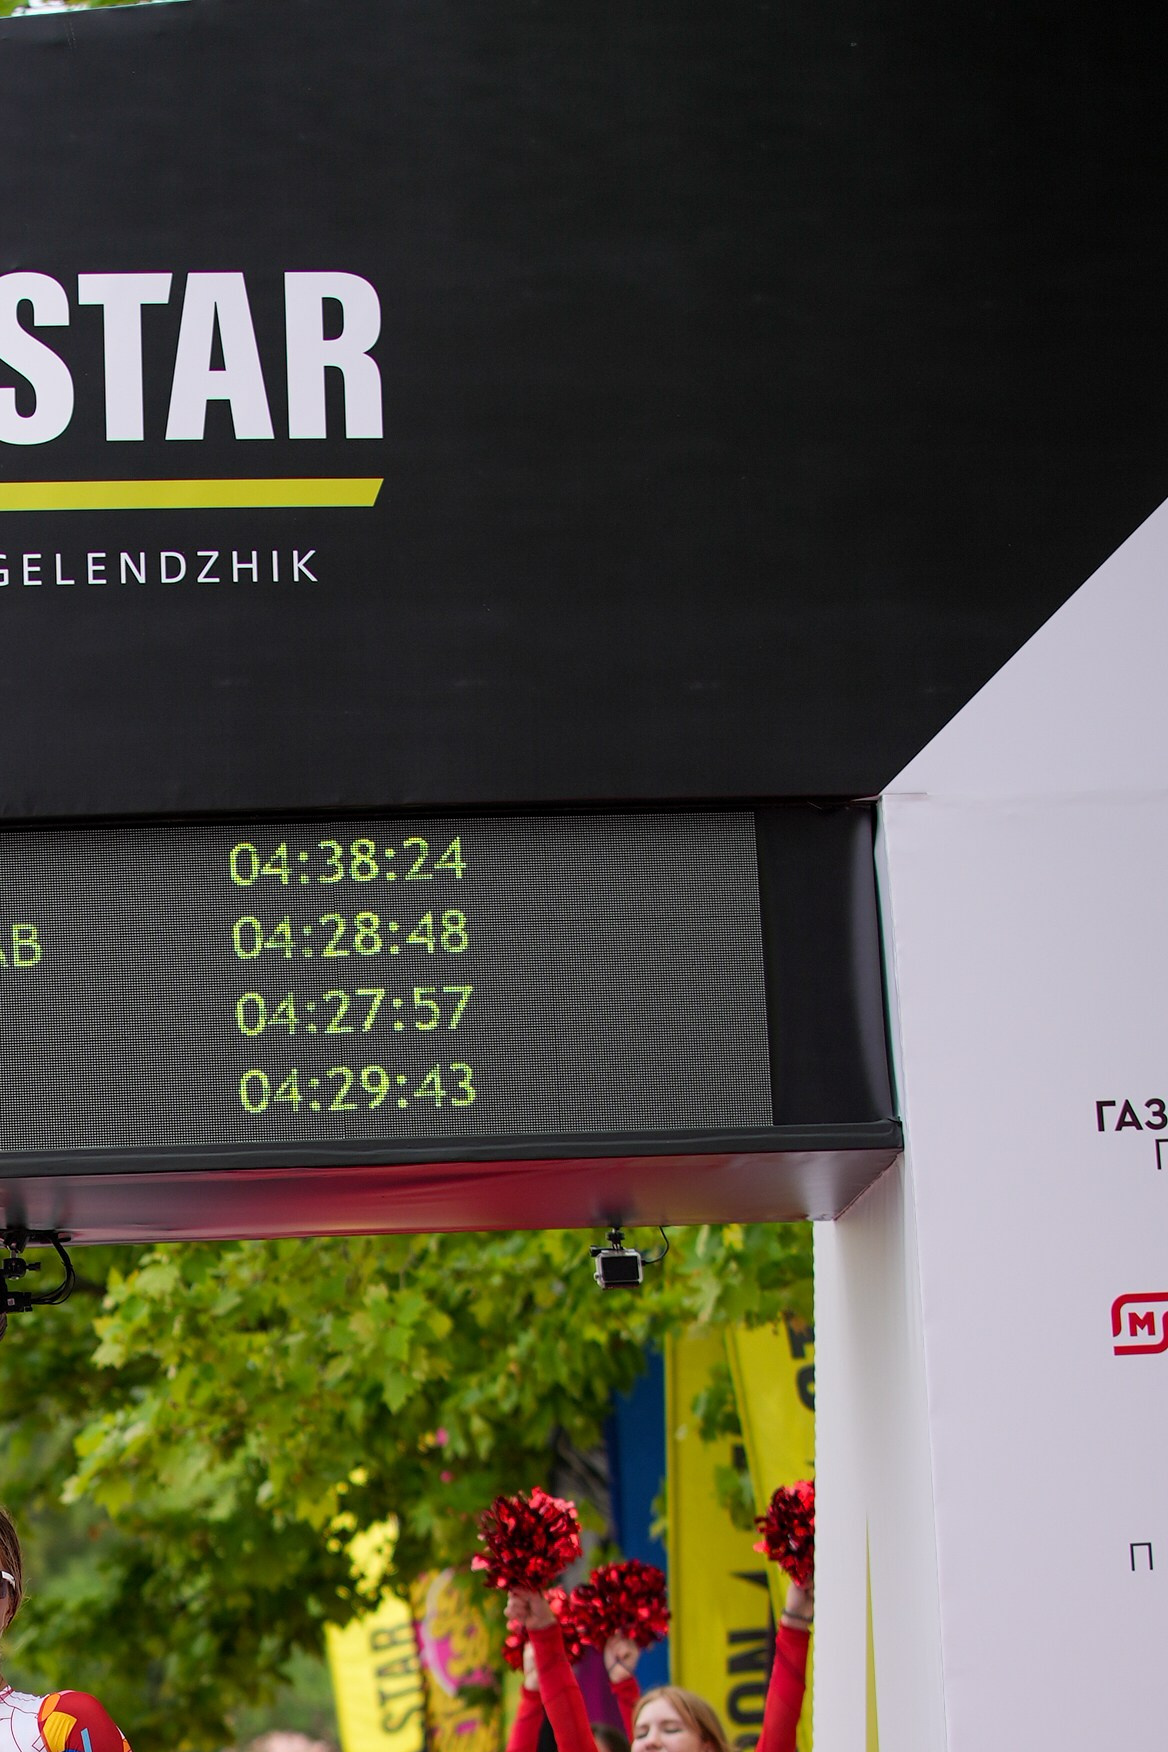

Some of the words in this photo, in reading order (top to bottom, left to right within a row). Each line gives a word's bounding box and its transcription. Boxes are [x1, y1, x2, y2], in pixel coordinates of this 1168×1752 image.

[228, 834, 468, 888] 04:38:24
[231, 908, 470, 961] 04:28:48
[236, 983, 475, 1038] 04:27:57
[238, 1060, 478, 1115] 04:29:43
